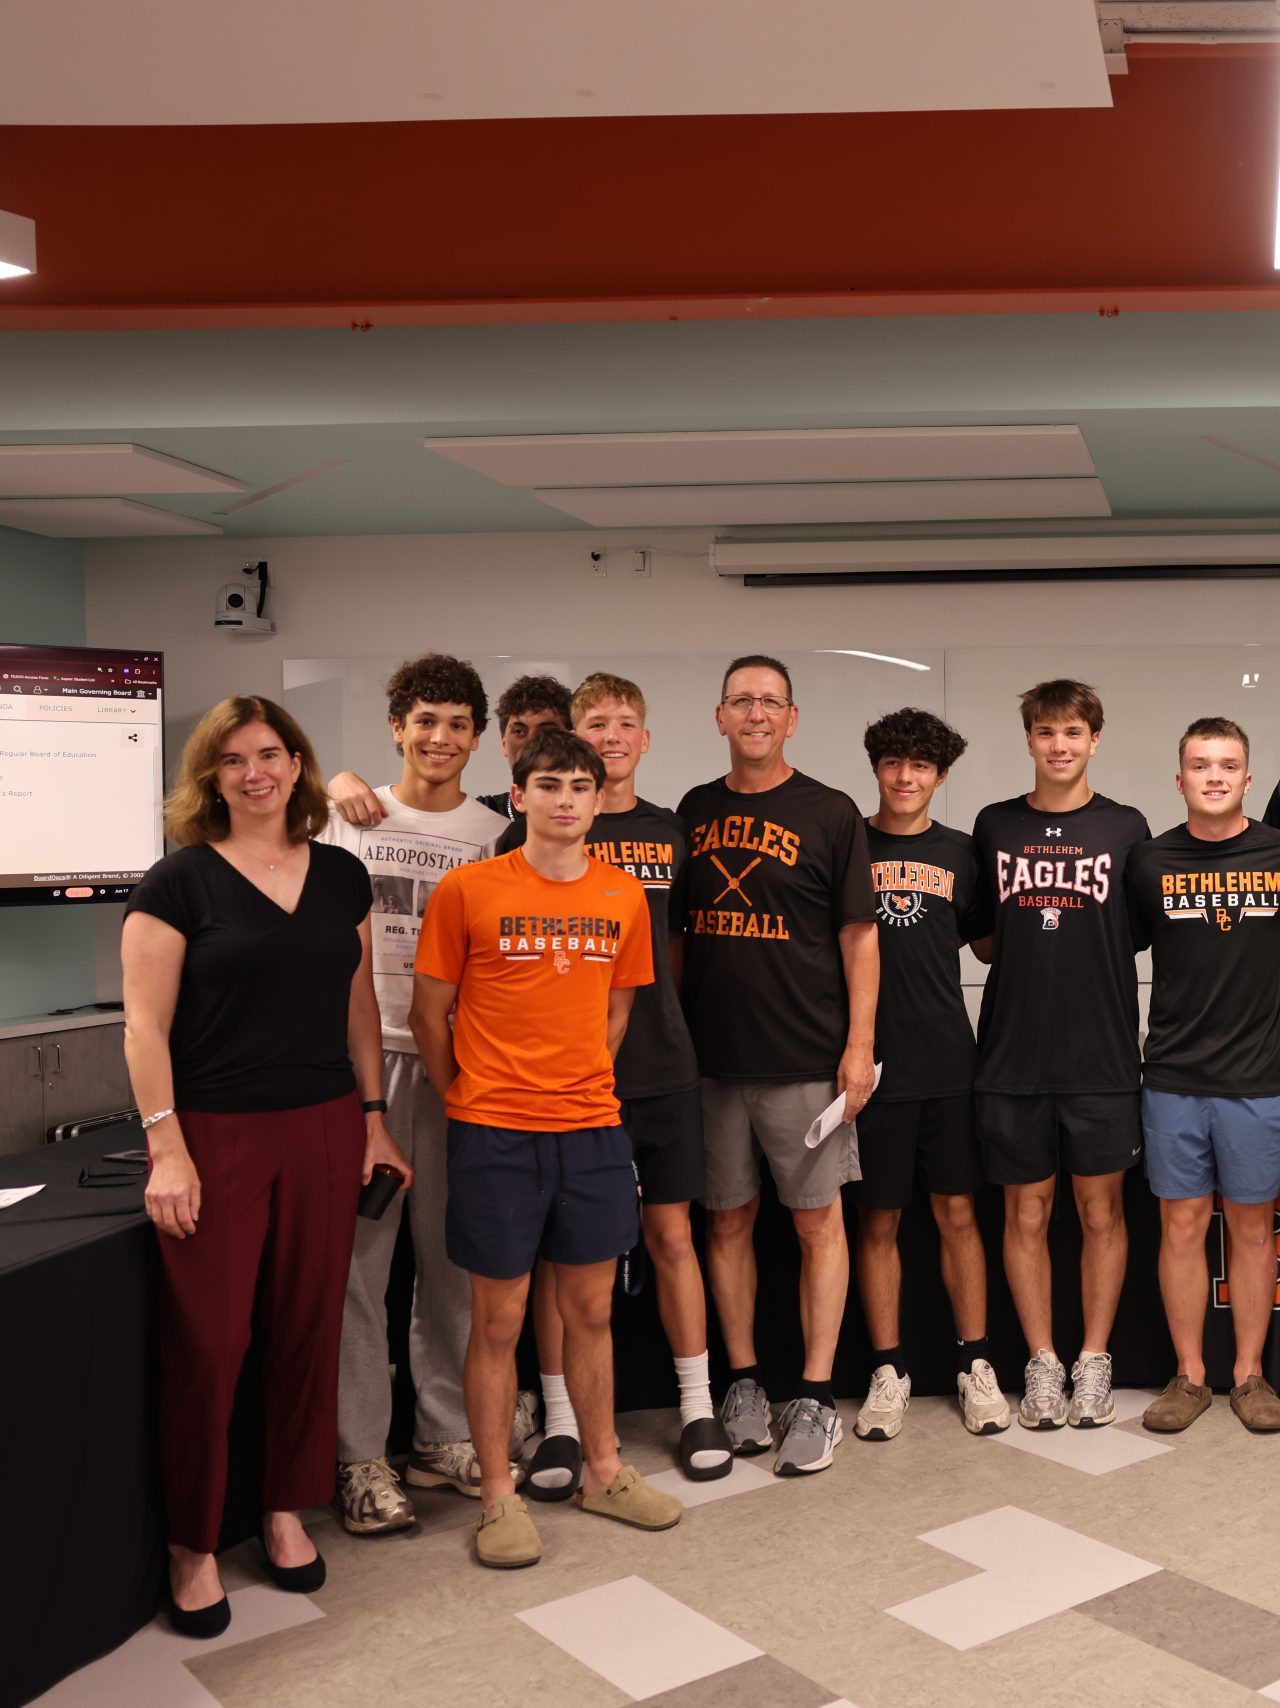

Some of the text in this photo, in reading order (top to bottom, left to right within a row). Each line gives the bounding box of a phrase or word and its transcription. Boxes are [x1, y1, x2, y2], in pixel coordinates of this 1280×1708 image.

[79, 688, 112, 696] Governing
[690, 816, 800, 867] EAGLES
[1024, 845, 1083, 854] BETHLEHEM
[364, 846, 475, 870] AEROPOSTAL
[871, 861, 954, 902] THLEHEM
[997, 850, 1112, 904] EAGLES
[1018, 896, 1084, 908] BASEBALL
[1163, 893, 1279, 909] BASEBALL
[876, 907, 927, 926] BASEBALL
[1216, 908, 1232, 931] BC
[386, 926, 408, 934] REG.
[500, 916, 620, 940] BETHLEHEM
[500, 937, 617, 954] BASEBALL
